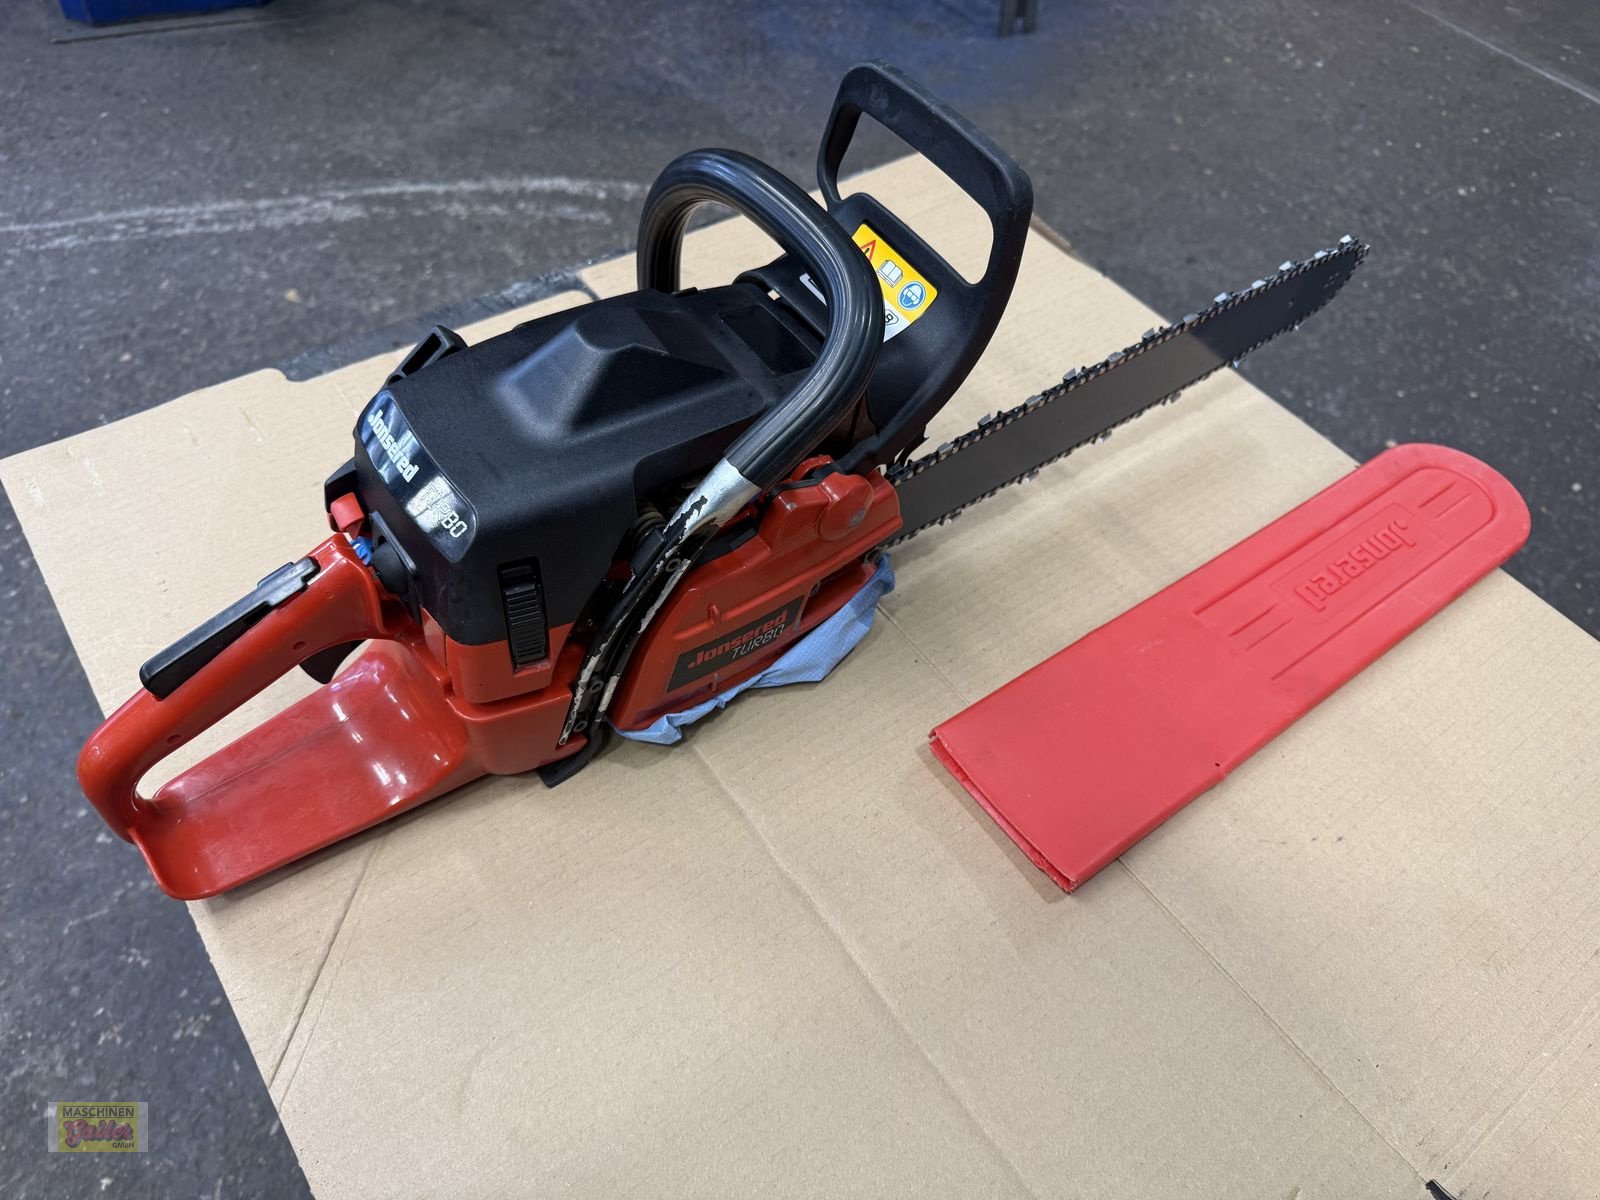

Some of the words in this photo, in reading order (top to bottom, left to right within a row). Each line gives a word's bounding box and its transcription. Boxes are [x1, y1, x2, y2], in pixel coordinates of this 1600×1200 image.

[367, 409, 420, 483] Jonsered
[1295, 520, 1417, 612] Jonsered
[687, 610, 788, 669] Jonsered
